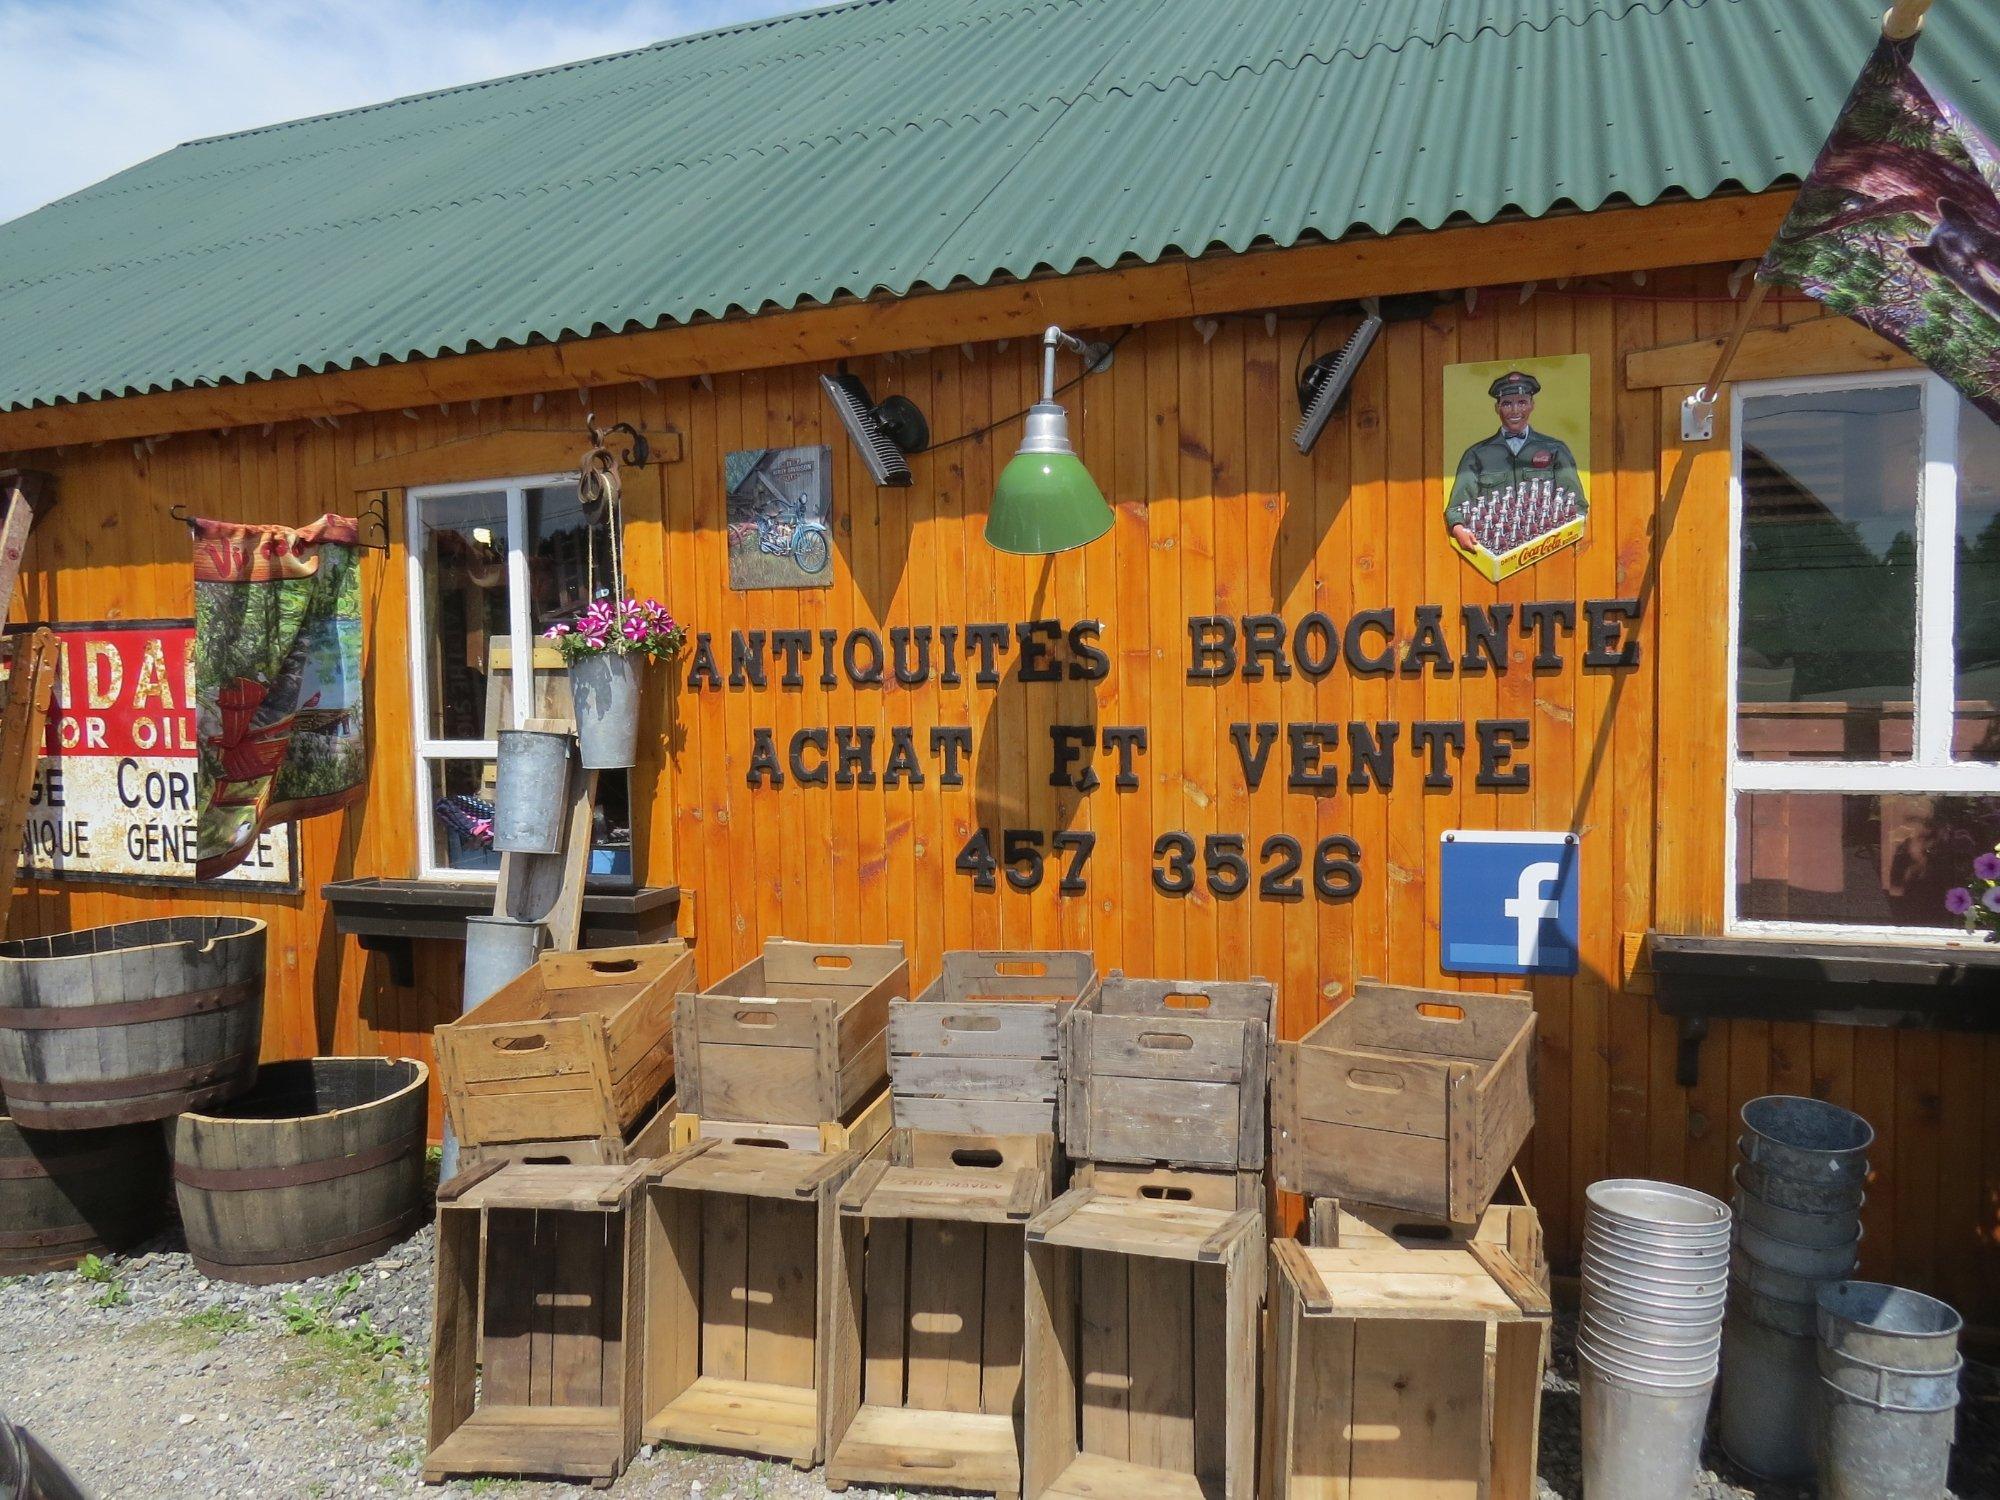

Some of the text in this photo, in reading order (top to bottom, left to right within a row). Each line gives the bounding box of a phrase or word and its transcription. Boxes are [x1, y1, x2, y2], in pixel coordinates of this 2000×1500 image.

[687, 599, 1641, 688] ANTIQUITES BROCANTE
[132, 716, 197, 749] OIL
[746, 719, 1530, 791] ACHAT ET VENTE
[22, 820, 90, 858] NIQUE
[955, 828, 1363, 900] 457 3526
